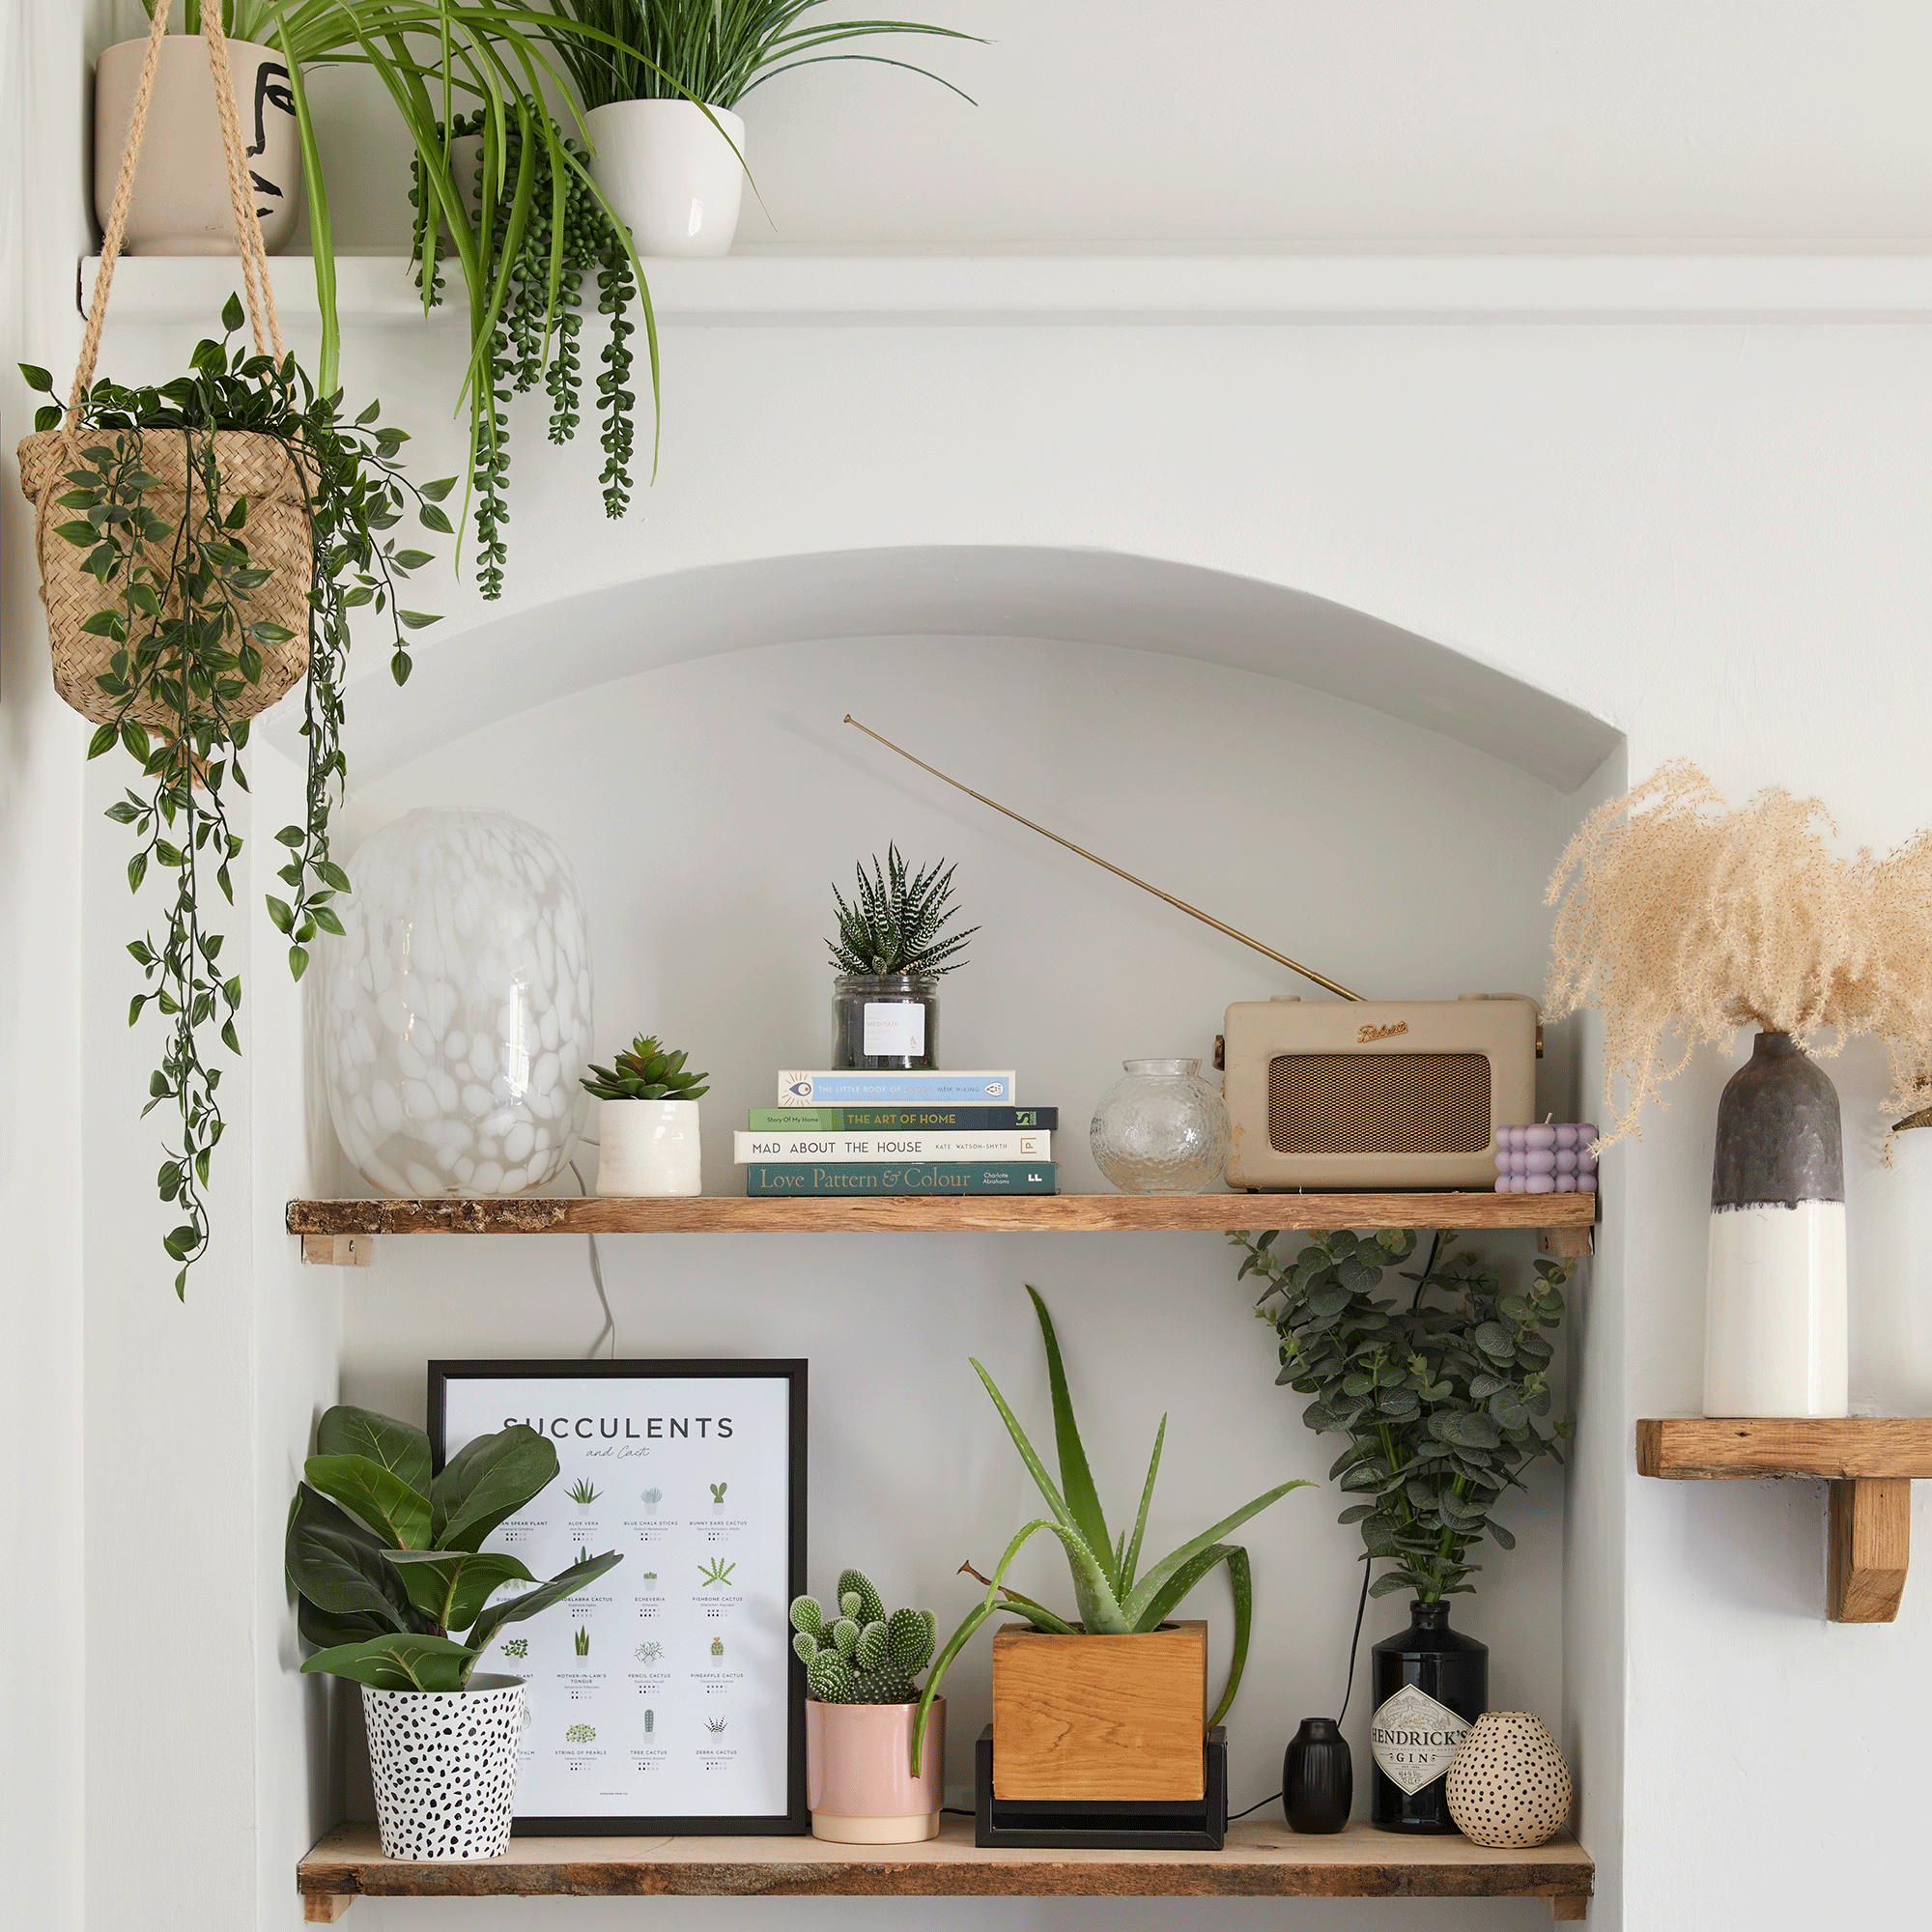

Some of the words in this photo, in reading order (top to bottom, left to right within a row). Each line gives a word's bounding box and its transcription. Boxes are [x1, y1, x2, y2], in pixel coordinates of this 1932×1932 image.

[1357, 1020, 1408, 1043] Roberts
[847, 1114, 870, 1124] THE
[874, 1114, 896, 1124] ART
[900, 1114, 917, 1124] OF
[920, 1114, 955, 1124] HOME
[753, 1142, 781, 1153] MAD
[790, 1142, 836, 1153] ABOUT
[845, 1142, 868, 1153] THE
[877, 1141, 923, 1152] HOUSE
[760, 1169, 805, 1188] Love
[813, 1169, 877, 1188] Pattern
[882, 1170, 901, 1188] &
[904, 1167, 971, 1188] Colour
[585, 1445, 613, 1457] and
[617, 1444, 651, 1460] Cacti
[1372, 1727, 1468, 1746] HENDRICK'S
[1396, 1752, 1428, 1763] GIN
